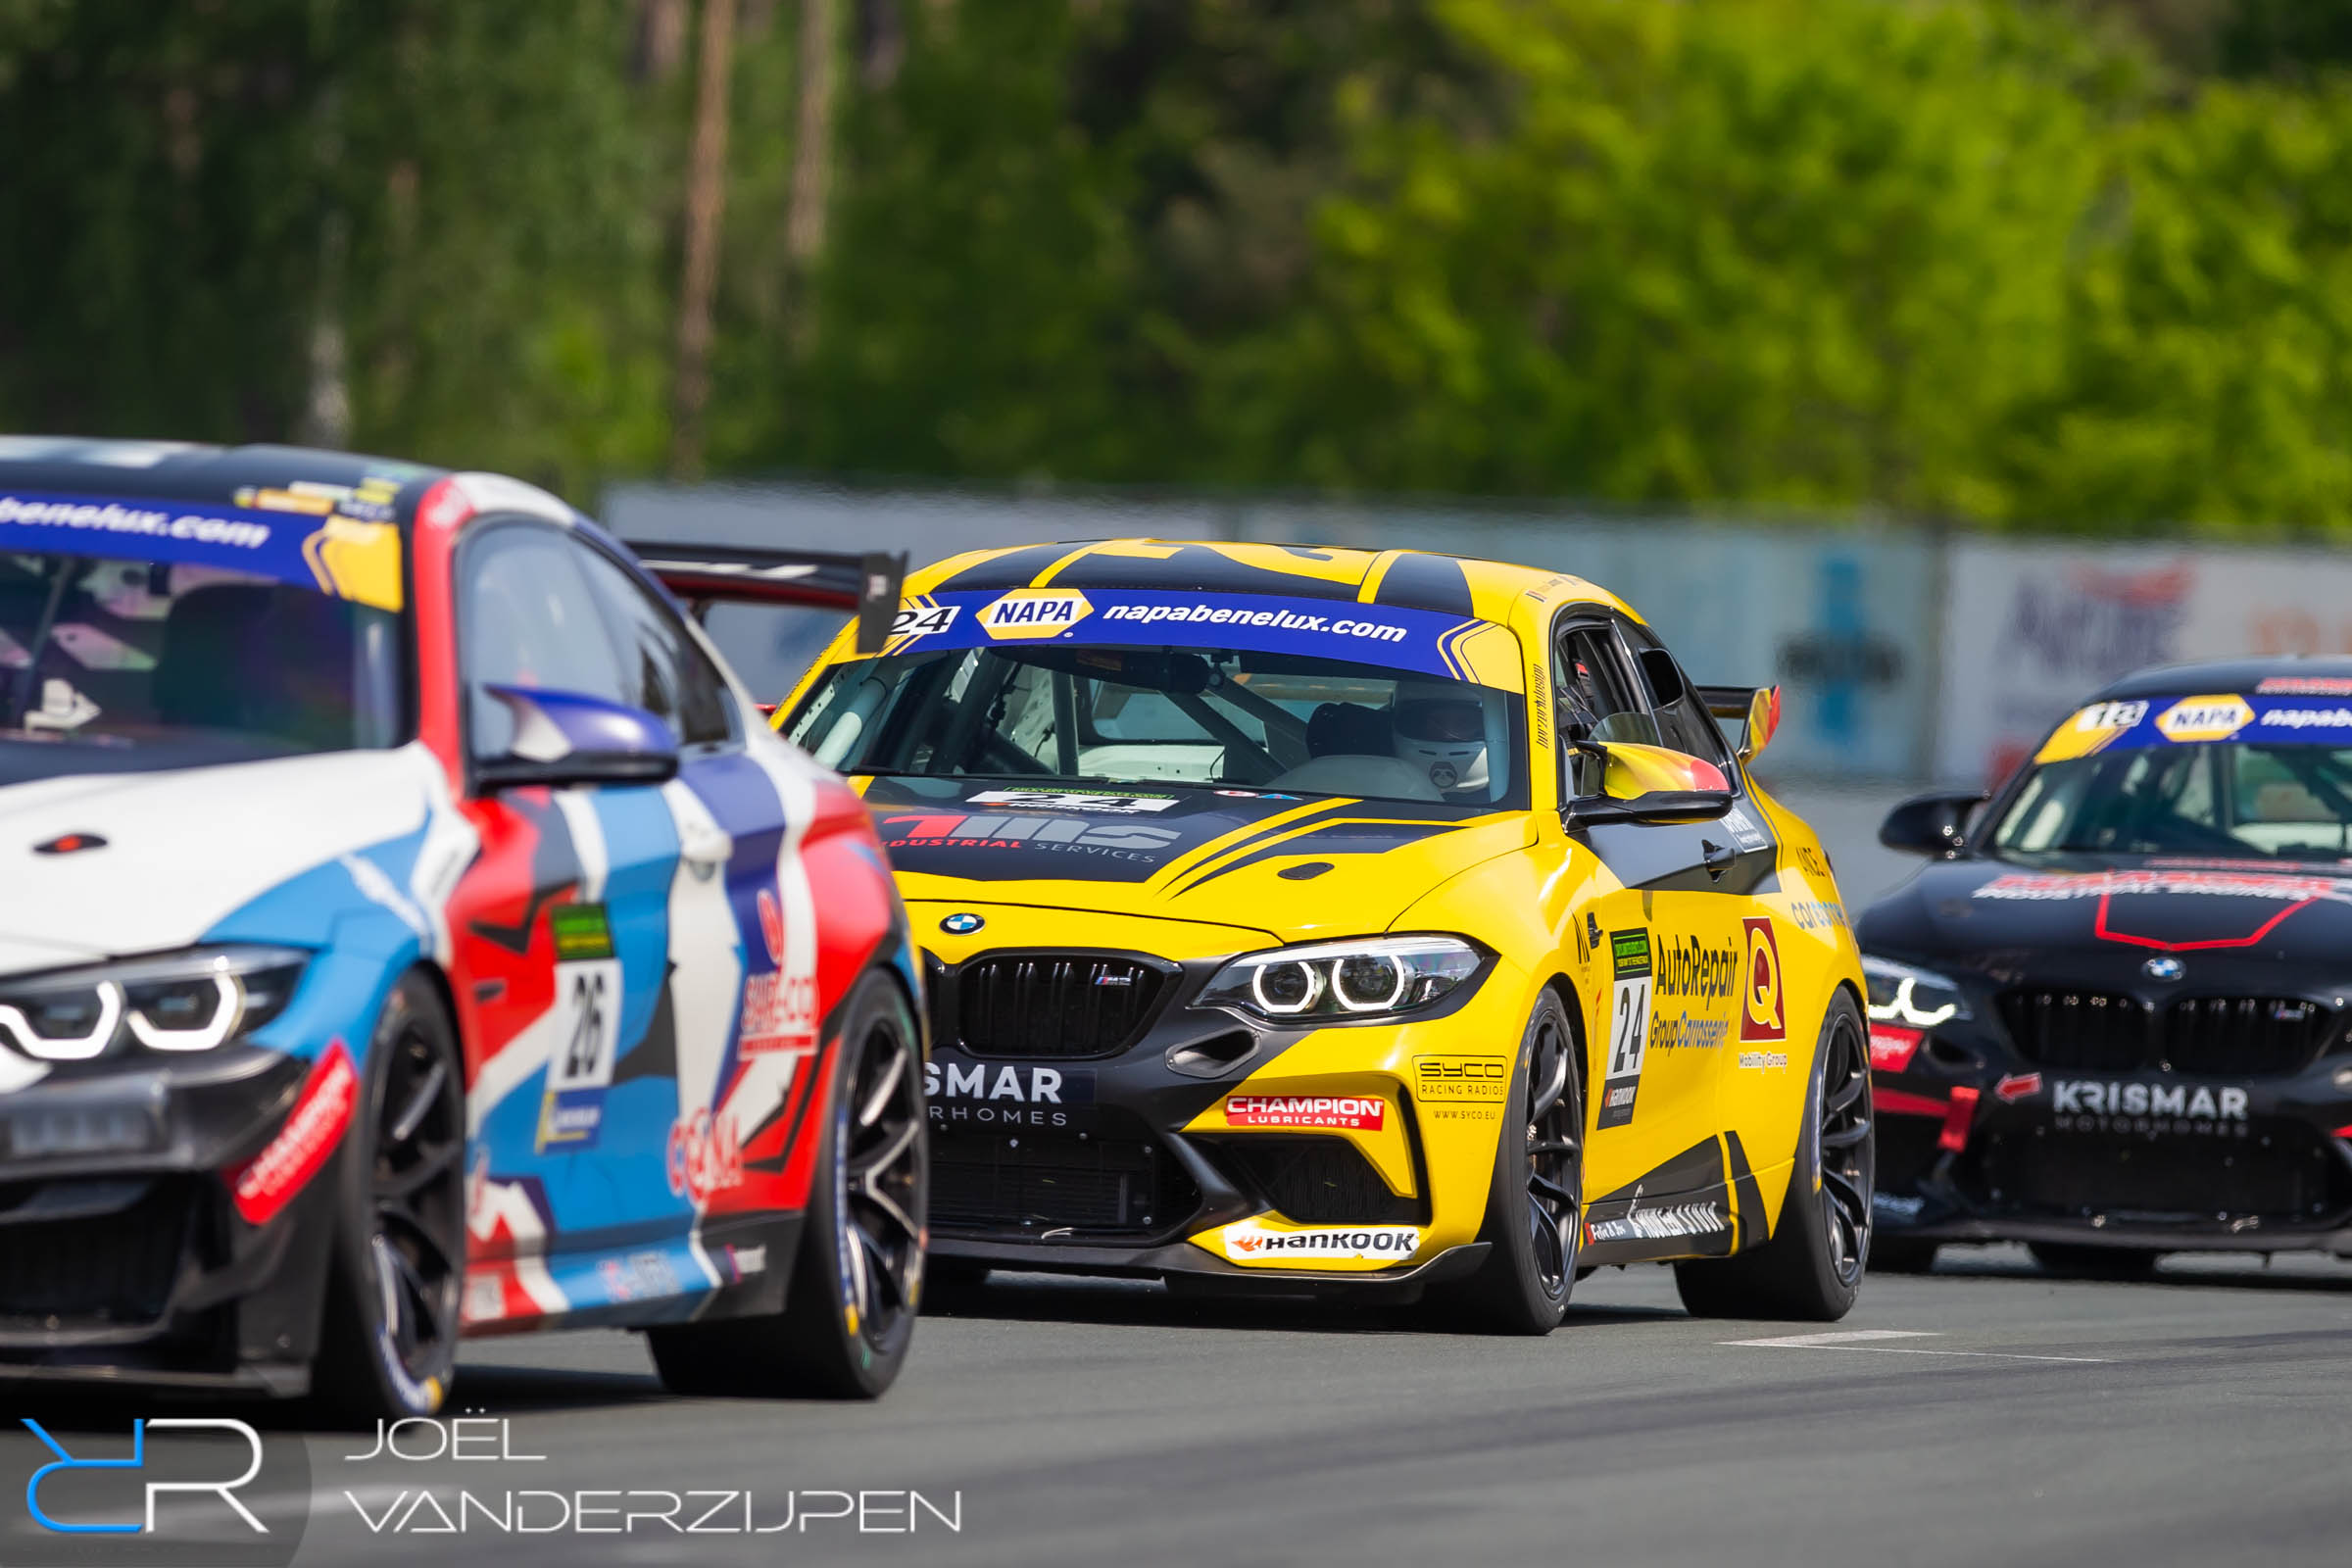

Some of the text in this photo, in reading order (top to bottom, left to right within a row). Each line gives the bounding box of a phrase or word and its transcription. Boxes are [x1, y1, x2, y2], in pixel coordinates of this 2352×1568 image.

[0, 497, 270, 549] benelux.com
[891, 608, 953, 634] 24
[994, 601, 1074, 624] NAPA
[1103, 605, 1407, 643] napabenelux.com
[2174, 709, 2237, 726] NAPA
[881, 838, 1155, 863] DUSTRIAL SERVICES
[1655, 933, 1739, 1011] AutoRepair
[1613, 983, 1645, 1073] 24
[924, 1062, 1063, 1103] SMAR
[1419, 1062, 1504, 1078] SYCO
[1422, 1084, 1504, 1096] RACING RADIOS
[2053, 1080, 2249, 1120] KRISMAR
[929, 1105, 1067, 1126] RHOMES
[1227, 1097, 1380, 1117] CHAMPION
[1248, 1115, 1360, 1127] LUBRICANTS
